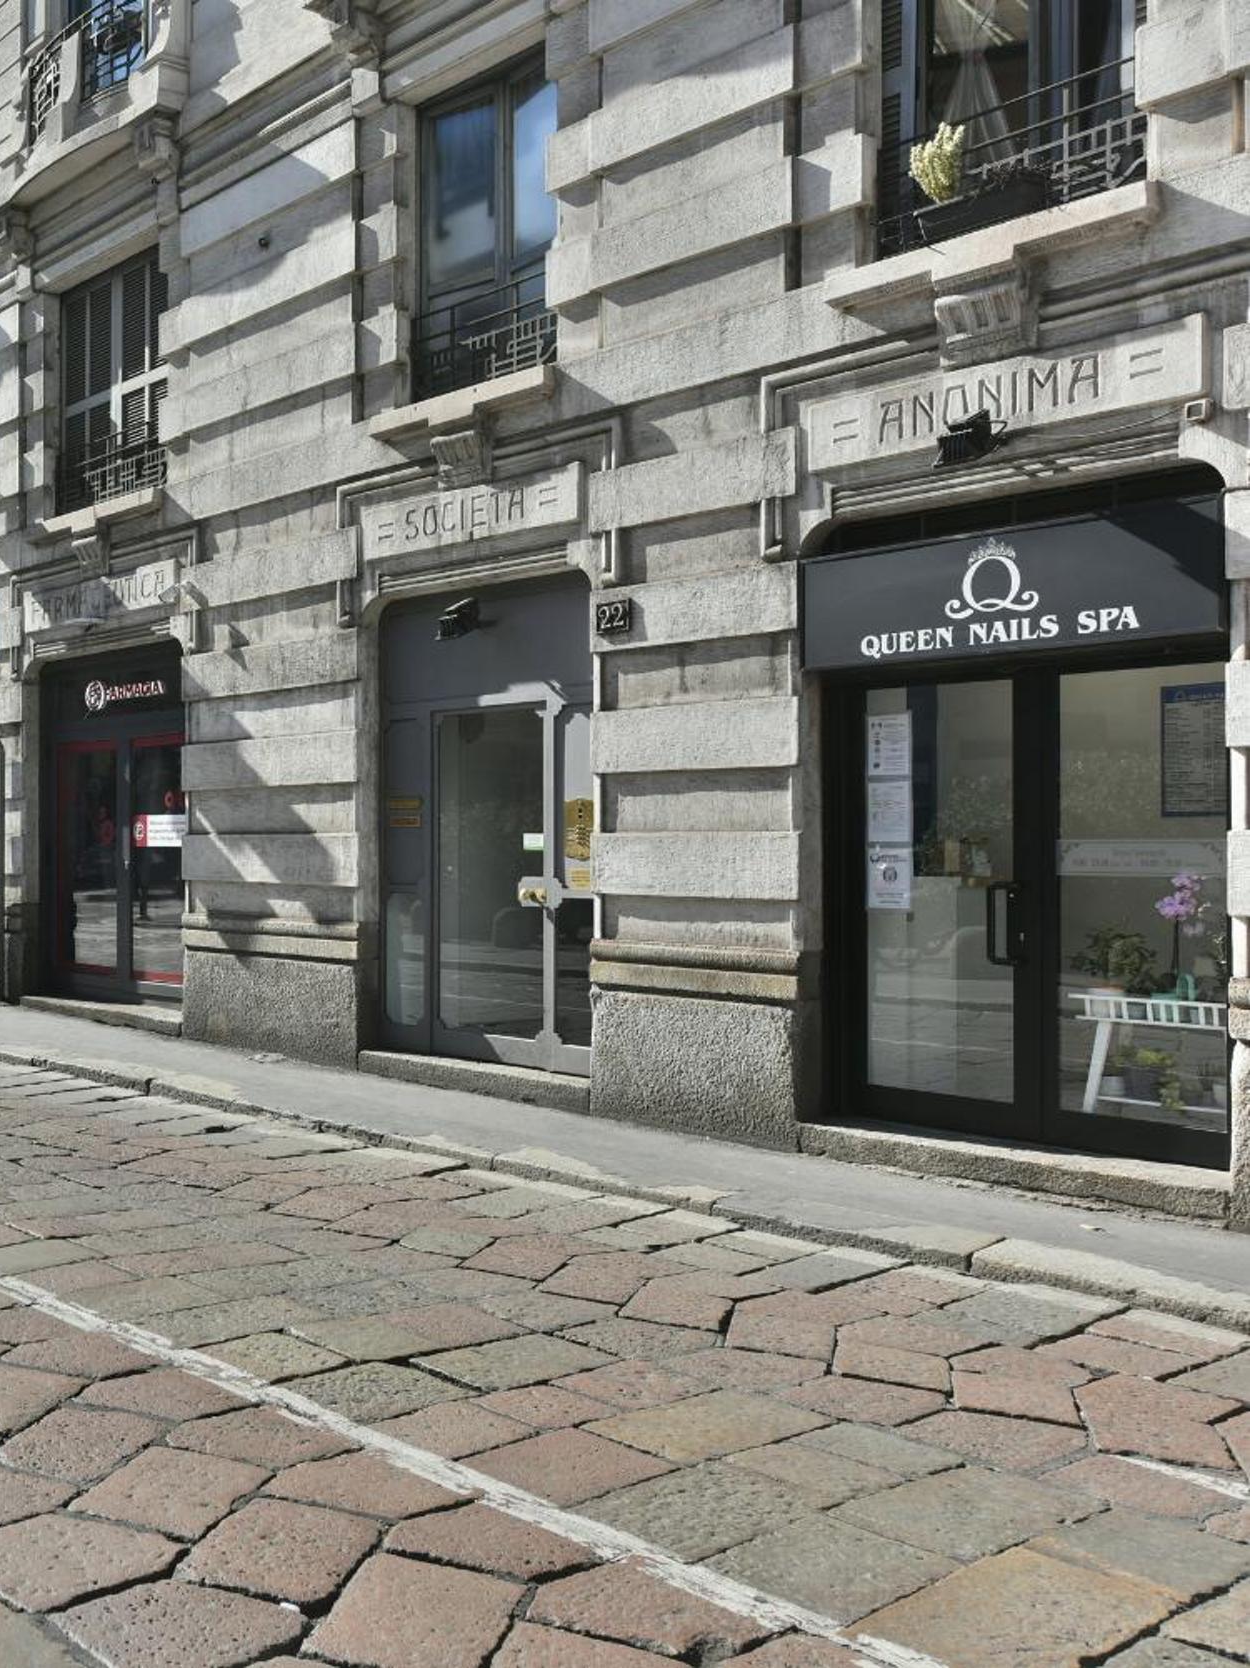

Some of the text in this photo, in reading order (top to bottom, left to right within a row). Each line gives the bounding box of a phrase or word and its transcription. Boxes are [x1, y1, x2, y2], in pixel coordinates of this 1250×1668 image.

[879, 352, 1099, 445] ANONIMA
[599, 603, 624, 629] 22
[861, 606, 1140, 659] QUEEN NAILS SPA
[106, 680, 164, 701] FARMACIA
